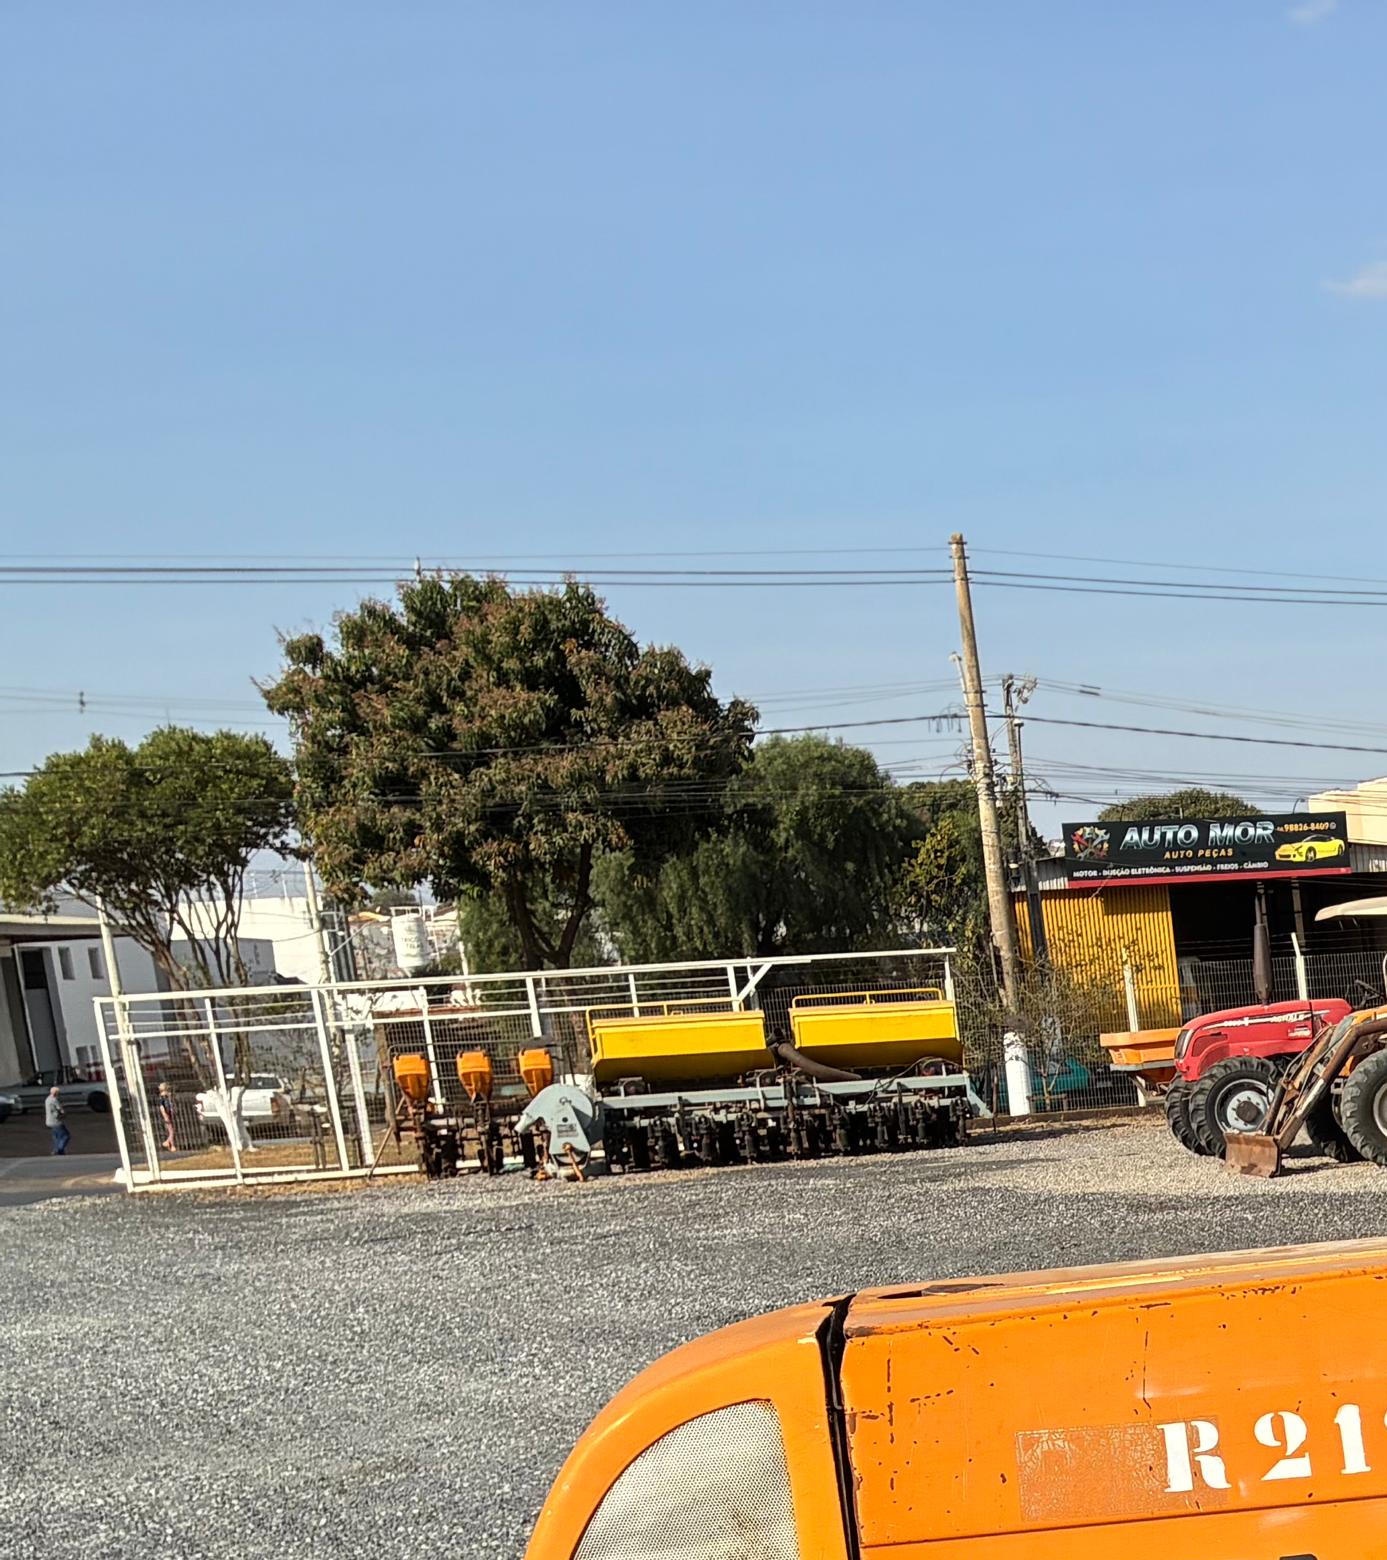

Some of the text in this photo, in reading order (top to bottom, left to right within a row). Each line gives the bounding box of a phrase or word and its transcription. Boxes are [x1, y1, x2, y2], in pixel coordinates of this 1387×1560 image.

[1119, 821, 1276, 850] AUTO MOR
[1163, 847, 1234, 859] AUTO PEÇAS
[1073, 870, 1098, 878] MOTOR
[1156, 1419, 1232, 1493] R
